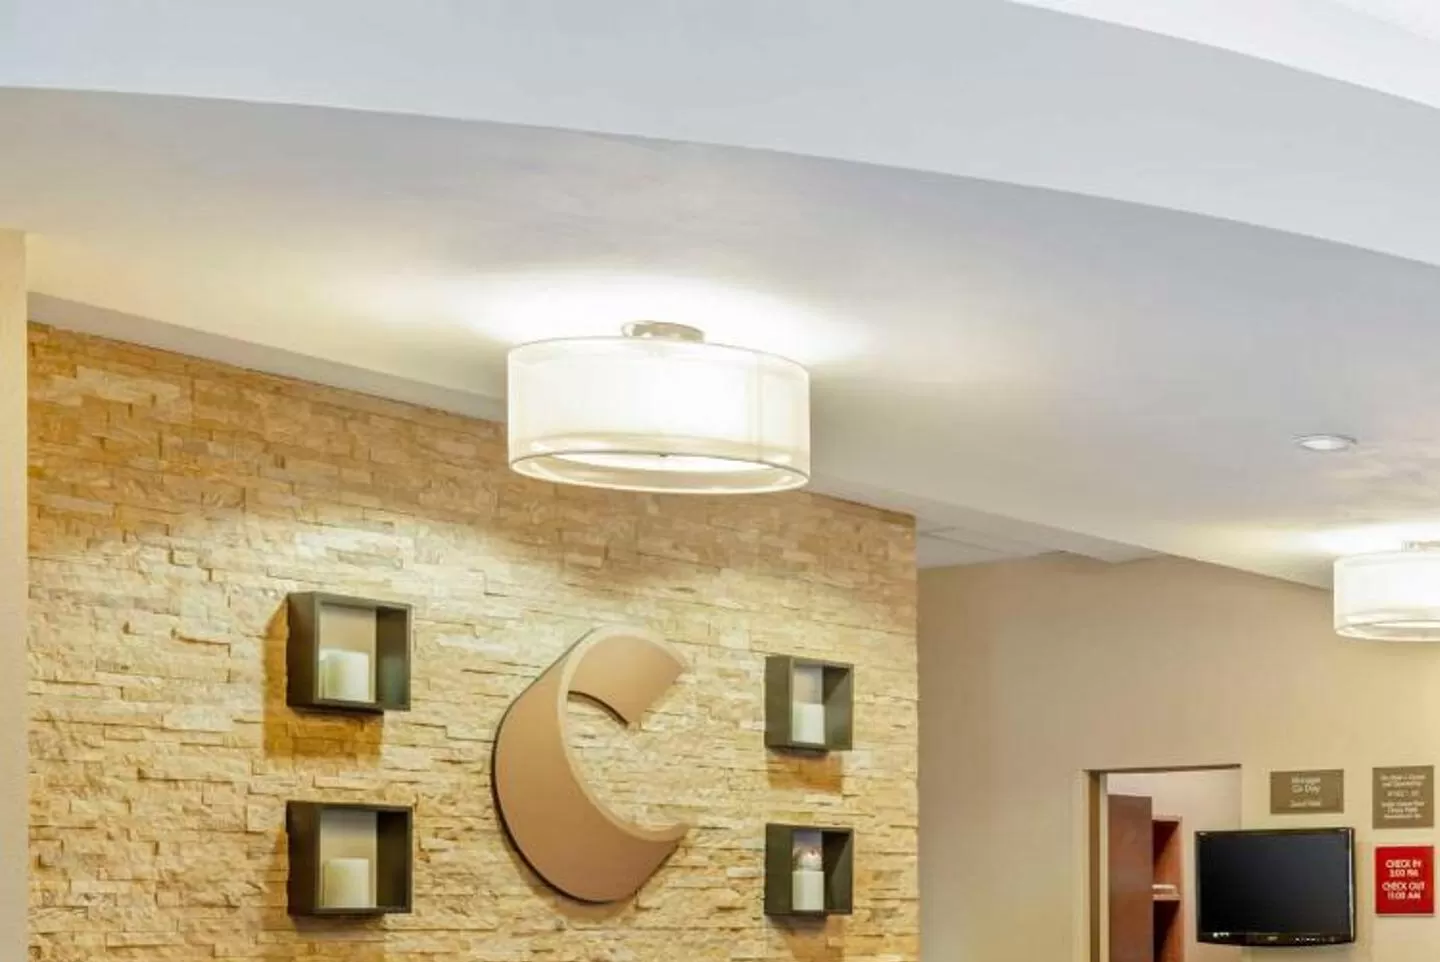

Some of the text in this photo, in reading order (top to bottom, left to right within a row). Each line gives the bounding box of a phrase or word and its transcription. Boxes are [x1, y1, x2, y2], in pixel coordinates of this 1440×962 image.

[1385, 859, 1412, 868] CHECK
[1381, 881, 1426, 891] CHECK OUT
